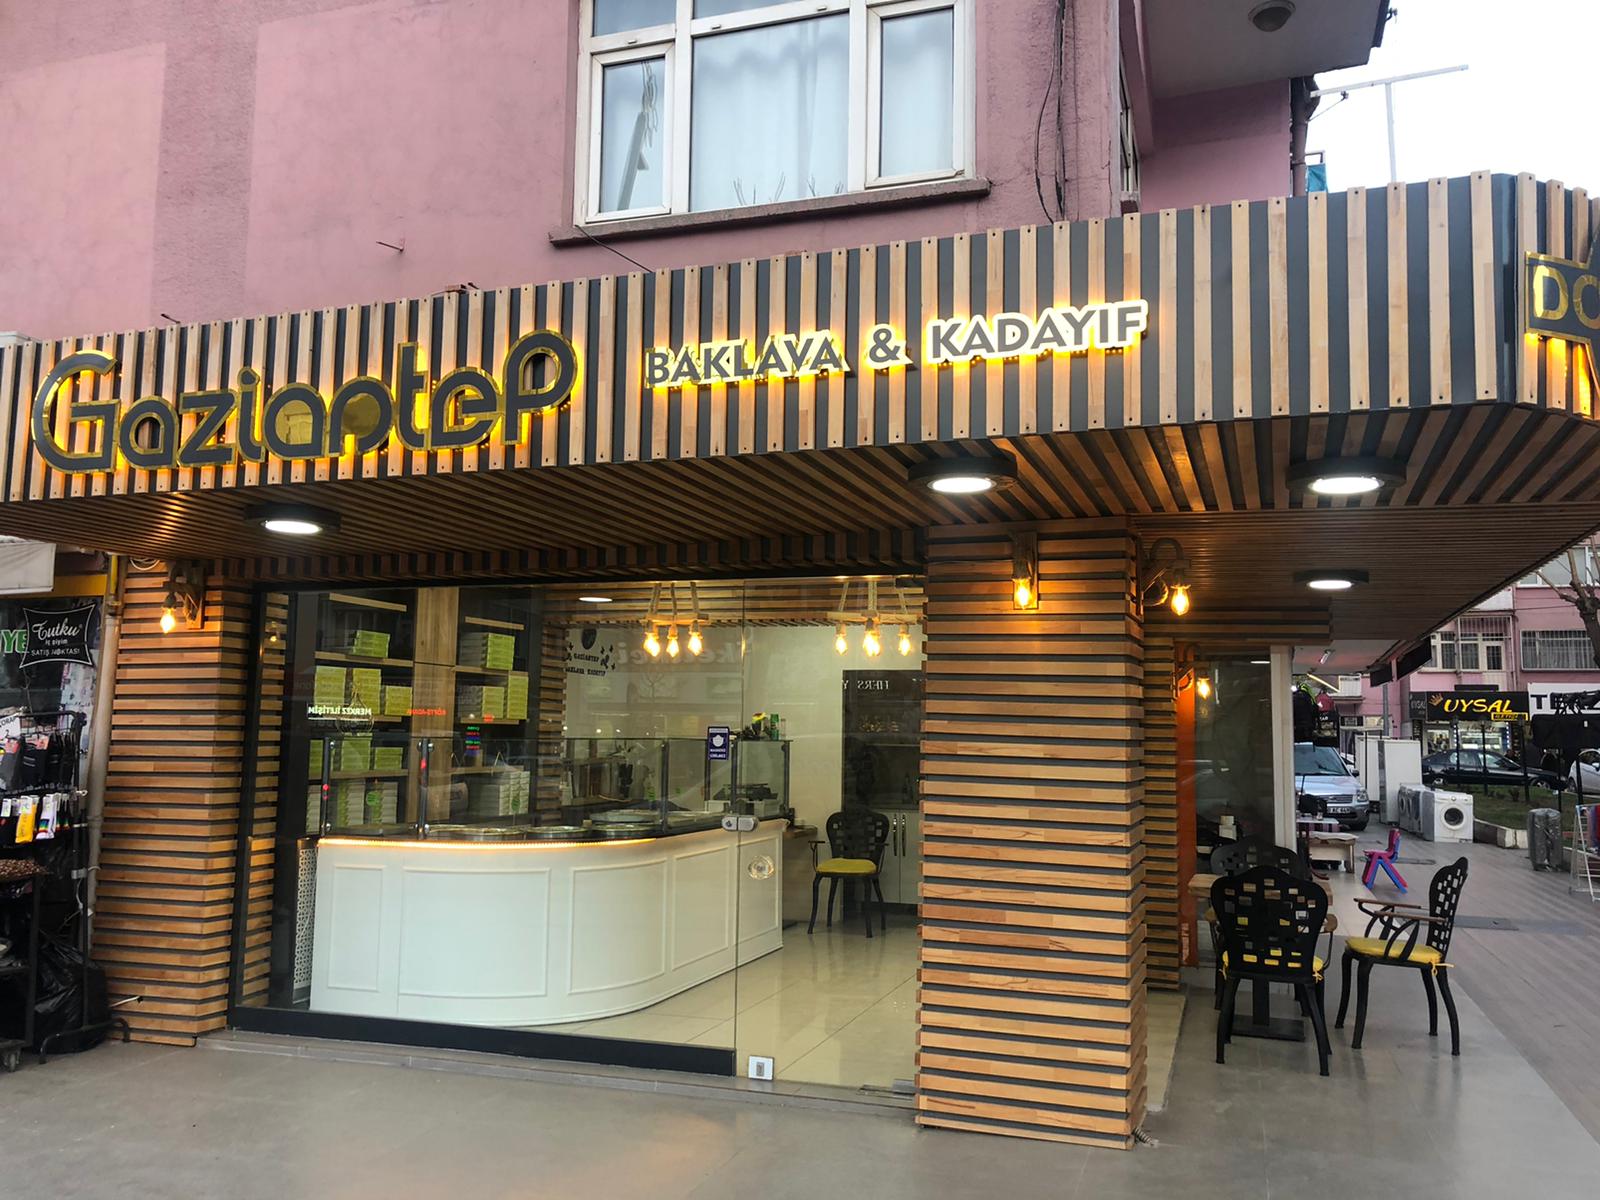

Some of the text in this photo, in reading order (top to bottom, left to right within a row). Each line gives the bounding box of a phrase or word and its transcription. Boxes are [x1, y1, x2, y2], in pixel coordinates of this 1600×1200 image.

[645, 303, 1146, 387] BAKLAVA & KADAYIF
[31, 618, 80, 640] Tutku
[31, 648, 80, 657] SATIŞ NOKTASI
[1443, 698, 1513, 713] UYSAL
